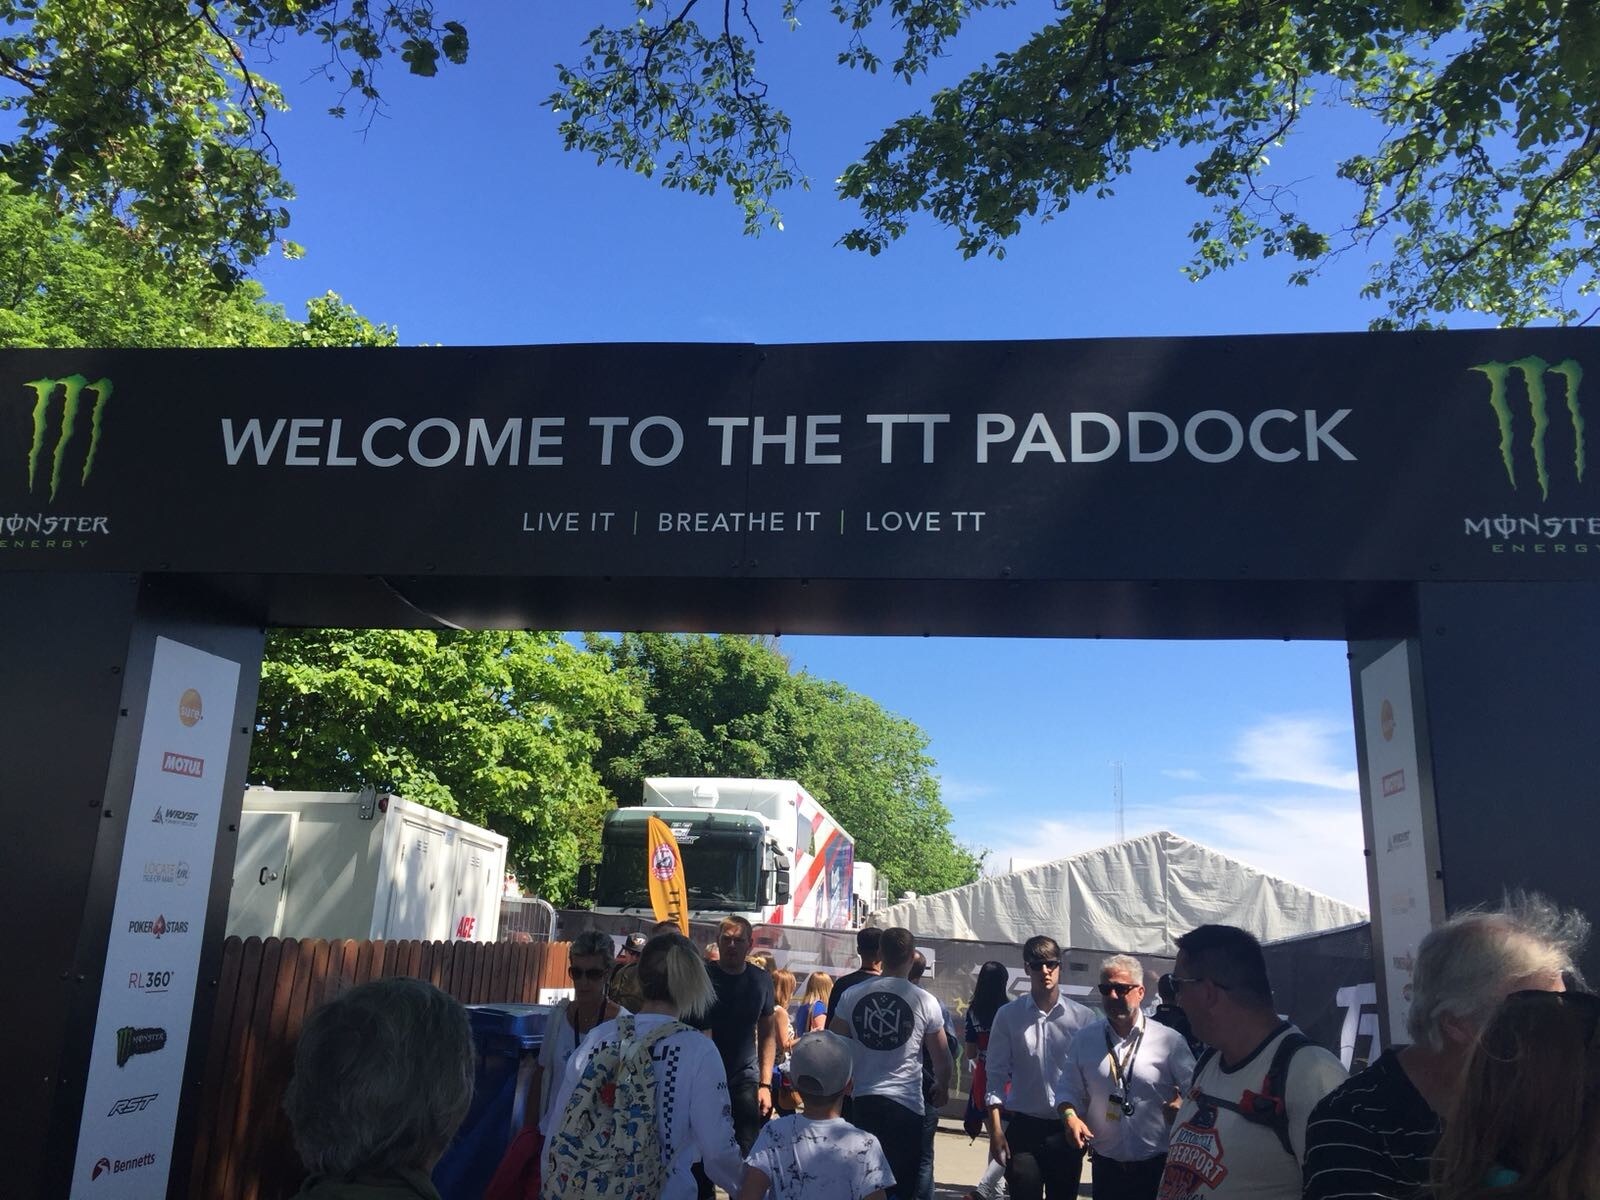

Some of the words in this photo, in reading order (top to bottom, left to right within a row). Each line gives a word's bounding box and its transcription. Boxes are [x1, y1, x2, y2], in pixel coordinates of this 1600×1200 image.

[222, 417, 566, 468] WELCOME
[589, 415, 685, 467] TO
[708, 414, 842, 466] THE
[866, 413, 951, 464] TT
[976, 408, 1358, 464] PADDOCK
[0, 513, 109, 536] ONSTER
[522, 512, 580, 532] LIVE
[591, 512, 616, 532] IT
[658, 511, 785, 532] BREATHE
[796, 511, 821, 532] IT
[866, 511, 941, 532] LOVE
[951, 511, 987, 532] TT
[1464, 513, 1600, 539] MONSTE
[164, 755, 204, 774] MOTUL
[165, 808, 199, 821] WRYST
[107, 1093, 159, 1117] RST
[113, 1152, 156, 1174] Bennetts
